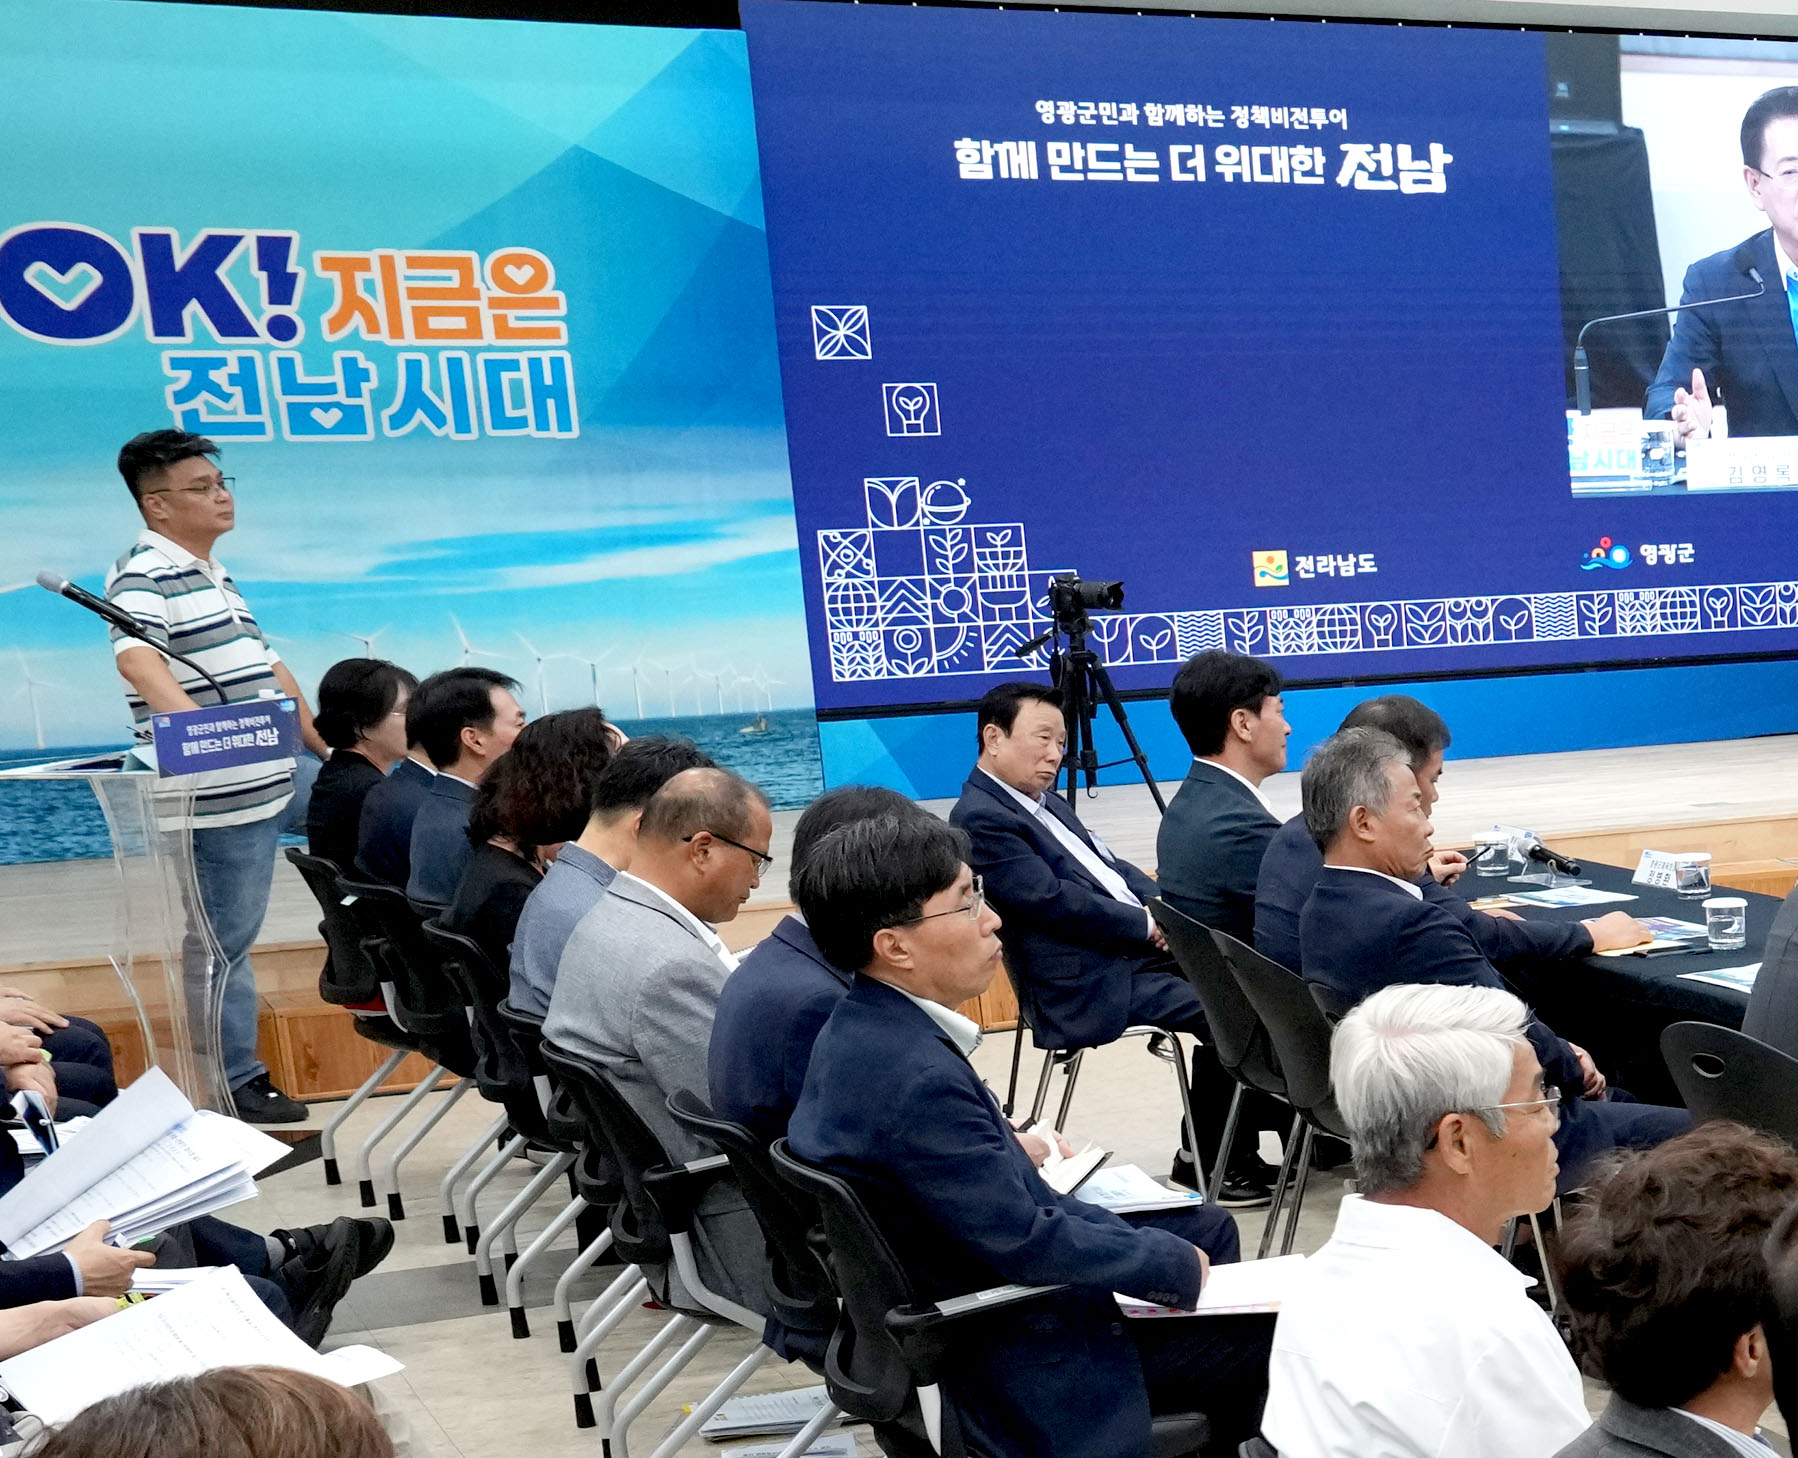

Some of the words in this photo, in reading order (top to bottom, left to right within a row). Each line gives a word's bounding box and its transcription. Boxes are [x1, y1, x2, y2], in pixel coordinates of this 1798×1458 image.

[1035, 100, 1140, 125] 영광군민과
[1143, 103, 1225, 128] 함께하는
[1230, 106, 1348, 131] 정책비전투어
[953, 137, 1038, 180] 함께
[1046, 140, 1160, 182] 만드는
[1170, 143, 1206, 182] 더
[1214, 143, 1325, 184] 위대한
[1335, 142, 1454, 194] 전남
[0, 221, 304, 346] OK!
[314, 248, 567, 346] 지금은
[1295, 553, 1377, 579] 전라남도
[1640, 543, 1695, 565] 영광군
[255, 727, 280, 747] 전남
